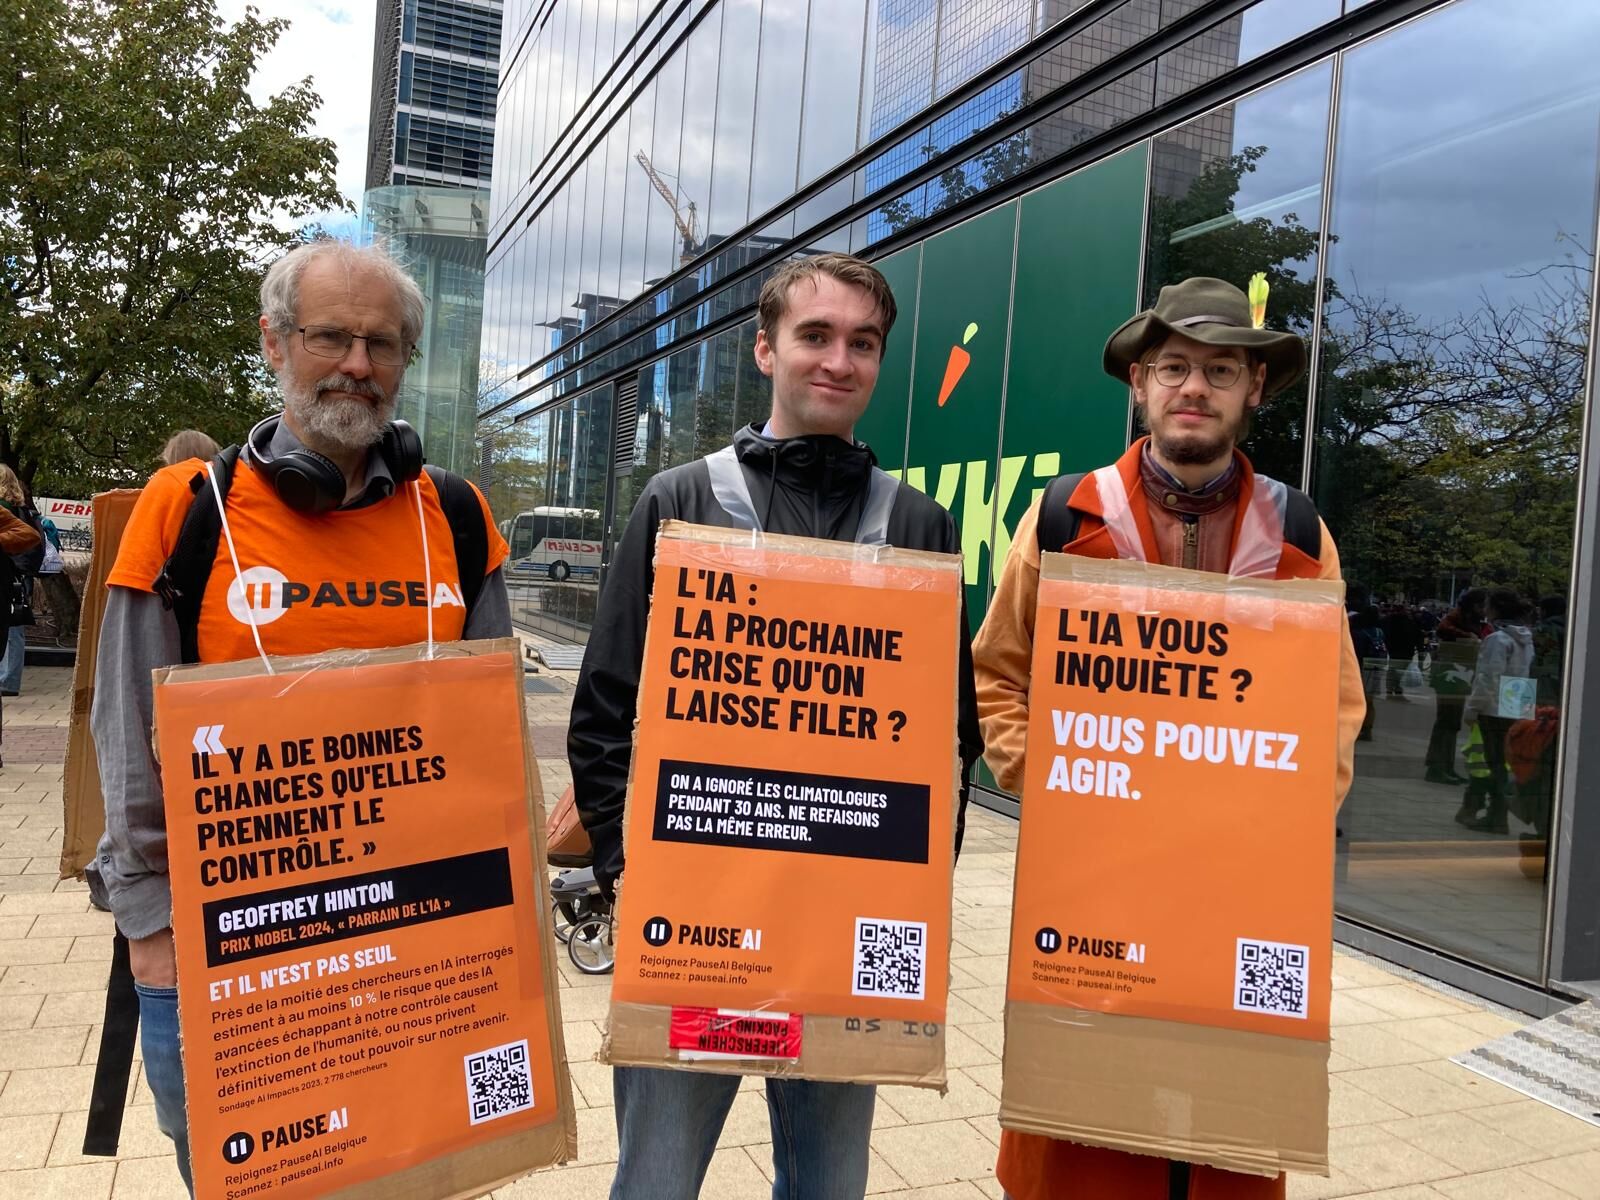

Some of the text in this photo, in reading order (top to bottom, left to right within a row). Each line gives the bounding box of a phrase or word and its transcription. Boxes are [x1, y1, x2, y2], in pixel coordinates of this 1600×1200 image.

[678, 567, 757, 606] L'IA :
[673, 606, 903, 661] LA PROCHAINE
[1057, 608, 1229, 656] L'IA VOUS
[670, 646, 865, 697] CRISE QU'ON
[1054, 650, 1253, 703] INQUIÈTE ?
[665, 687, 907, 742] LAISSE FILER ?
[192, 725, 423, 779] IL Y A DE BONNES
[1051, 709, 1299, 772] VOUS POUVEZ
[195, 756, 446, 815] CHANCES QU'ELLES
[670, 774, 888, 809] ON A IGNORÉ LES CLIMATOLOGUES
[1046, 755, 1142, 800] AGIR.
[197, 797, 385, 851] PRENNENT LE
[666, 814, 812, 841] PAS LA MÊME ERREUR.
[668, 794, 880, 828] PENDANT 30 ANS. NE REFAISONS
[200, 837, 376, 887] CONTRÔLE. »
[218, 880, 394, 933] GEOFFREY HINTON
[220, 897, 451, 955] PRIX NOBEL 2024, « PARRAIN DE L'IA »
[678, 924, 762, 951] PAUSEAI
[1067, 935, 1145, 963] PAUSEAI
[209, 944, 397, 1002] ET IL N'EST PAS SEUL
[212, 946, 514, 1023] Près de la moitié des chercheurs en IA interrogés
[639, 969, 681, 980] Scannez
[688, 973, 748, 985] pauseai.info
[640, 954, 773, 974] Rejoignez PauseAI Belgique
[1032, 972, 1069, 984] Scannez
[1077, 979, 1132, 993] pauseai.info
[1033, 960, 1156, 984] Rejoignez PauseAI Belgique
[213, 966, 493, 1042] estiment à au moins 10 % le risque que des IA
[214, 982, 499, 1061] avancées échappant à notre contrôle causent
[736, 1020, 788, 1037] PACKING
[216, 1004, 476, 1079] l'extinction de l'humanité, ou nous privent
[217, 1012, 510, 1098] définitivement de tout pouvoir sur notre avenir.
[699, 1034, 788, 1057] LIEFERSCHEIN
[218, 1098, 256, 1114] Sondage
[257, 1095, 266, 1103] AI
[267, 1086, 299, 1101] Impacts
[324, 1076, 329, 1084] 2
[331, 1072, 344, 1082] 778
[345, 1062, 388, 1077] chercheurs
[261, 1107, 348, 1152] PAUSEAI
[225, 1135, 368, 1186] Rejoignez PauseAI Belgique
[226, 1179, 272, 1200] Scannez
[281, 1157, 344, 1185] pauseai.info
